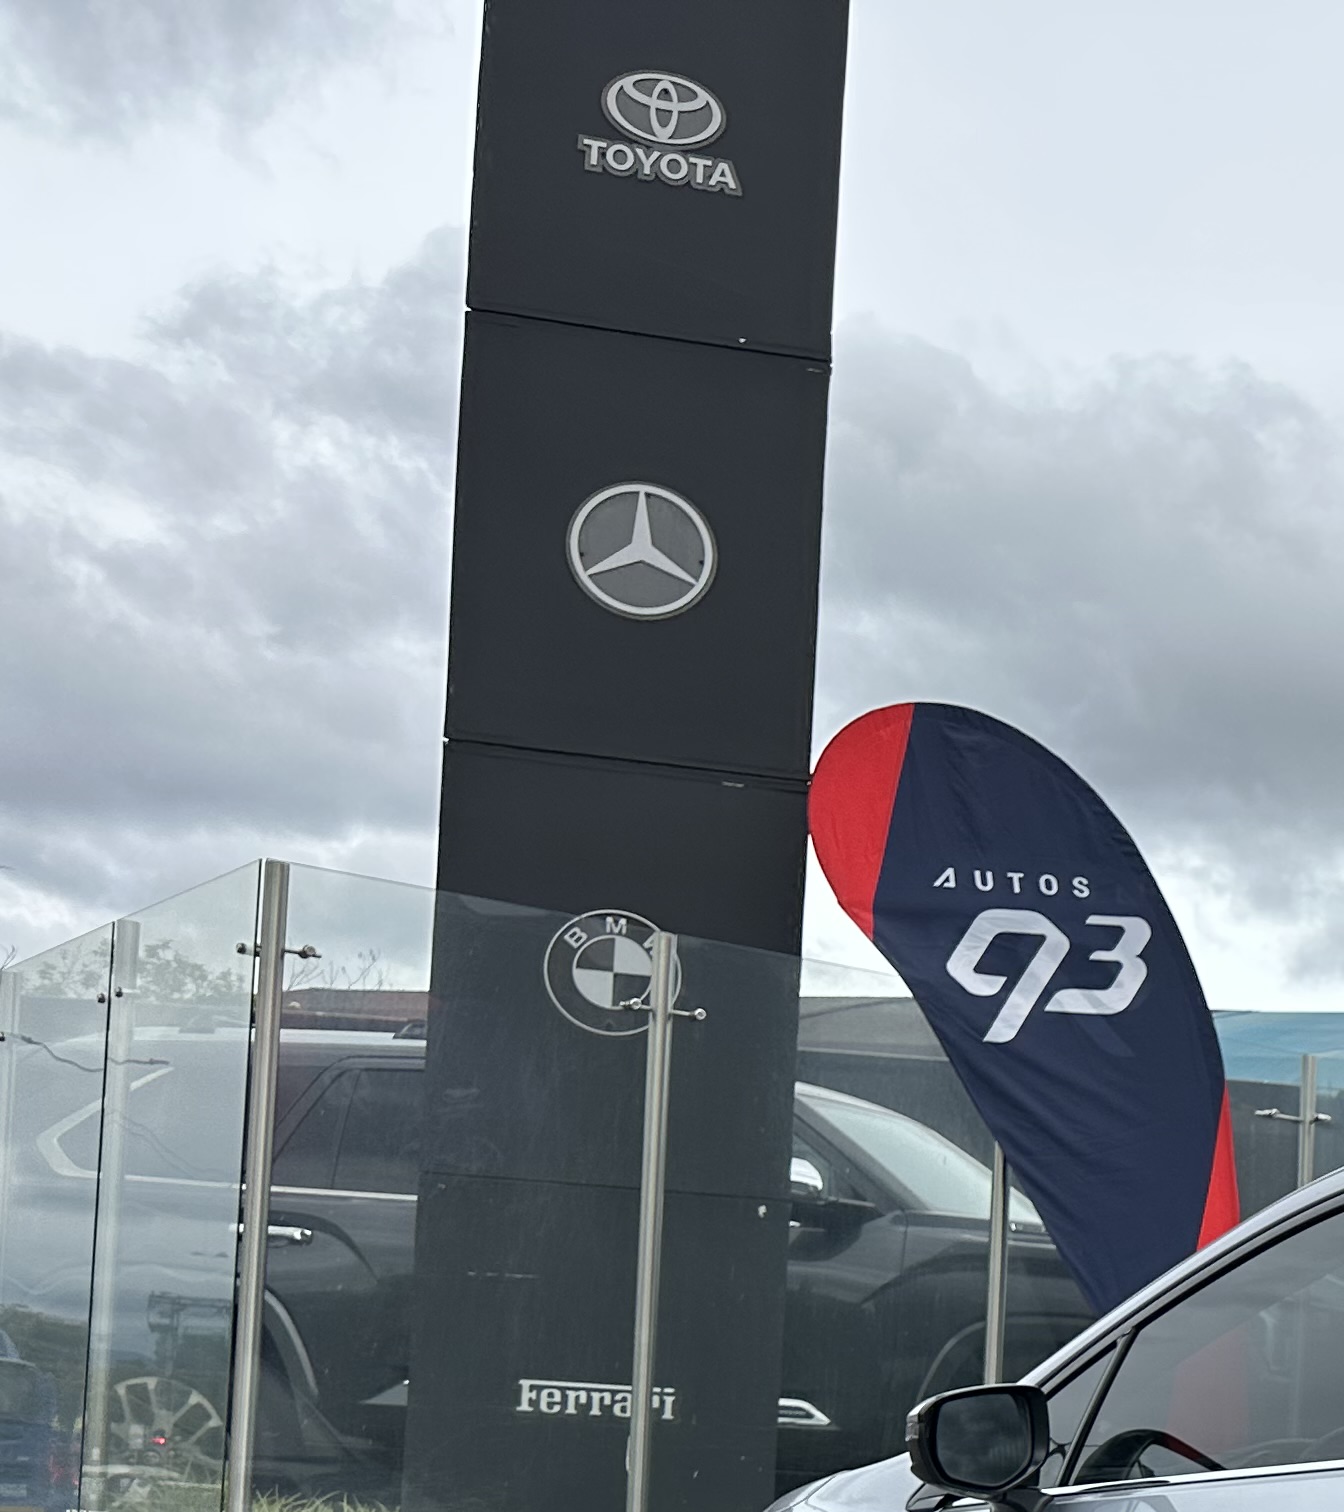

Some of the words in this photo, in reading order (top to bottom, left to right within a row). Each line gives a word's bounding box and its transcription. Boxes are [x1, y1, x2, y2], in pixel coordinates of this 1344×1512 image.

[582, 138, 738, 190] TOYOTA
[931, 866, 1092, 899] AUTOS
[945, 907, 1153, 1044] 93
